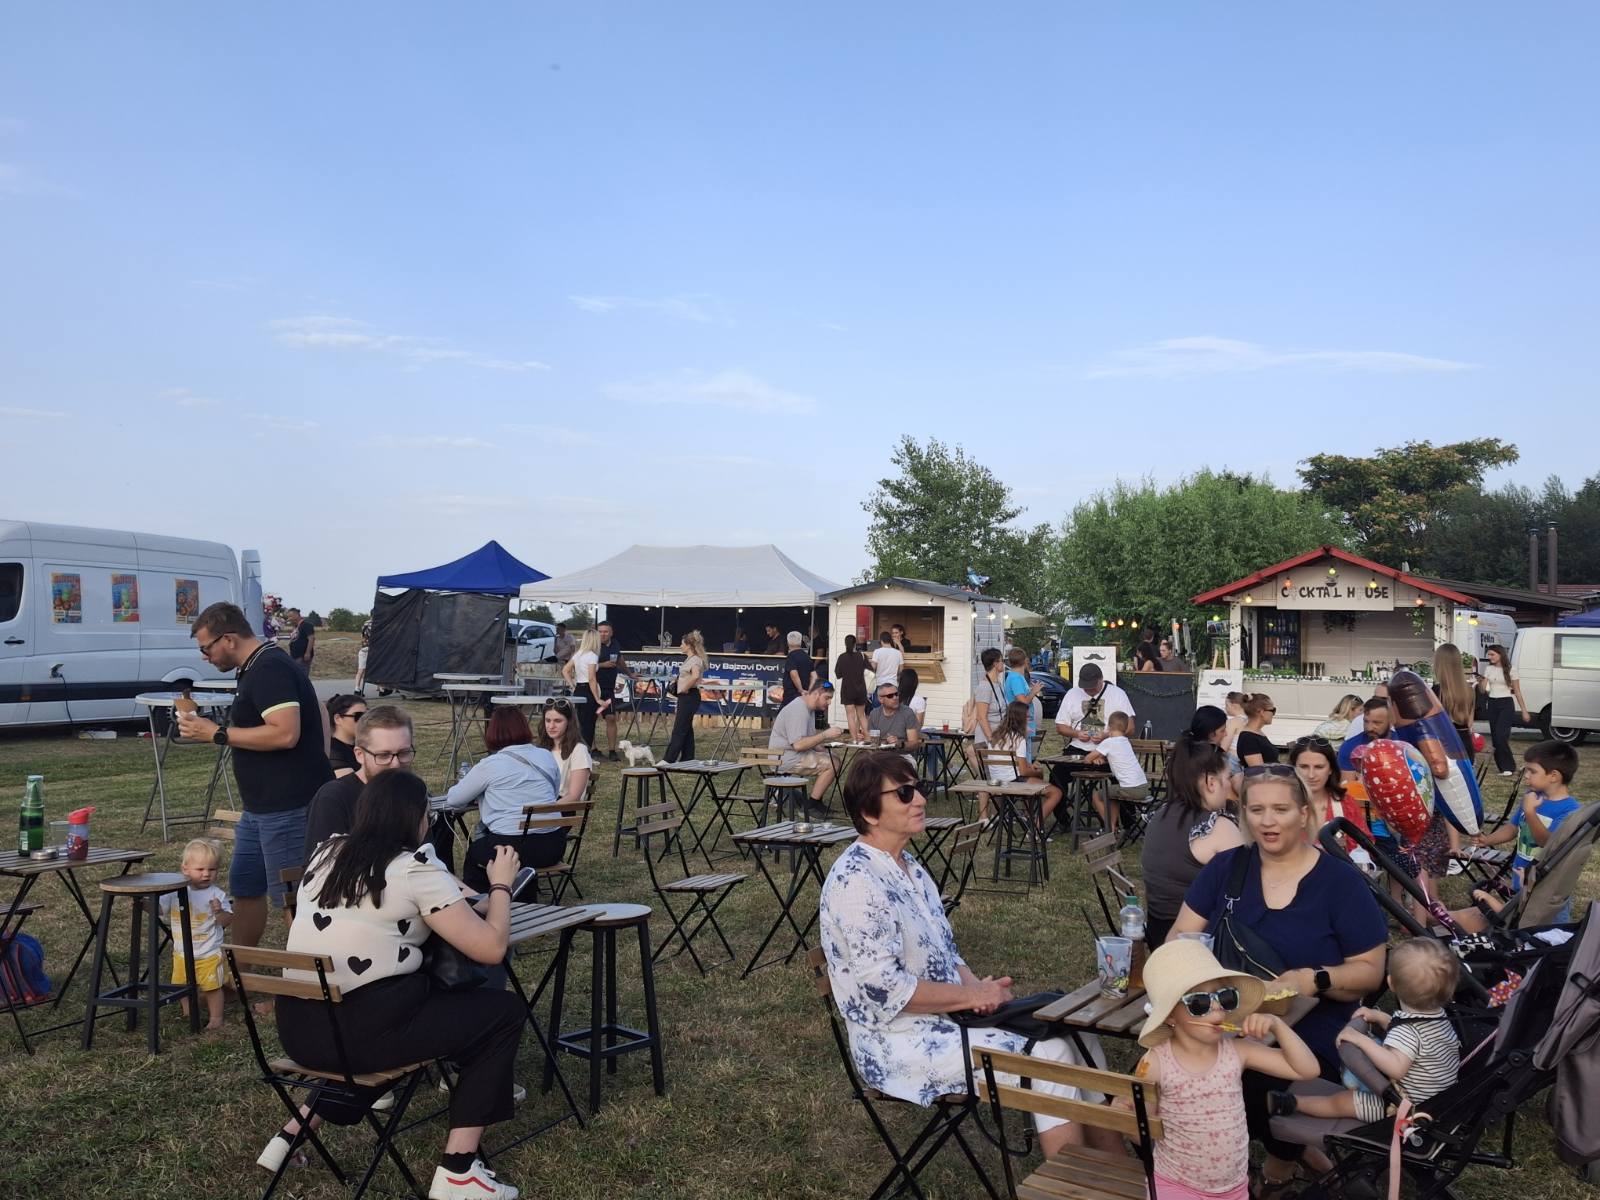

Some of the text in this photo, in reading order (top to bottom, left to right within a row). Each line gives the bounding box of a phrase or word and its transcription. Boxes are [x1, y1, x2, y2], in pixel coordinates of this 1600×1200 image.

[1281, 585, 1389, 599] CCKTAL HUSE
[709, 662, 721, 671] by
[722, 662, 754, 672] Bajzovi
[756, 663, 780, 672] Dvori
